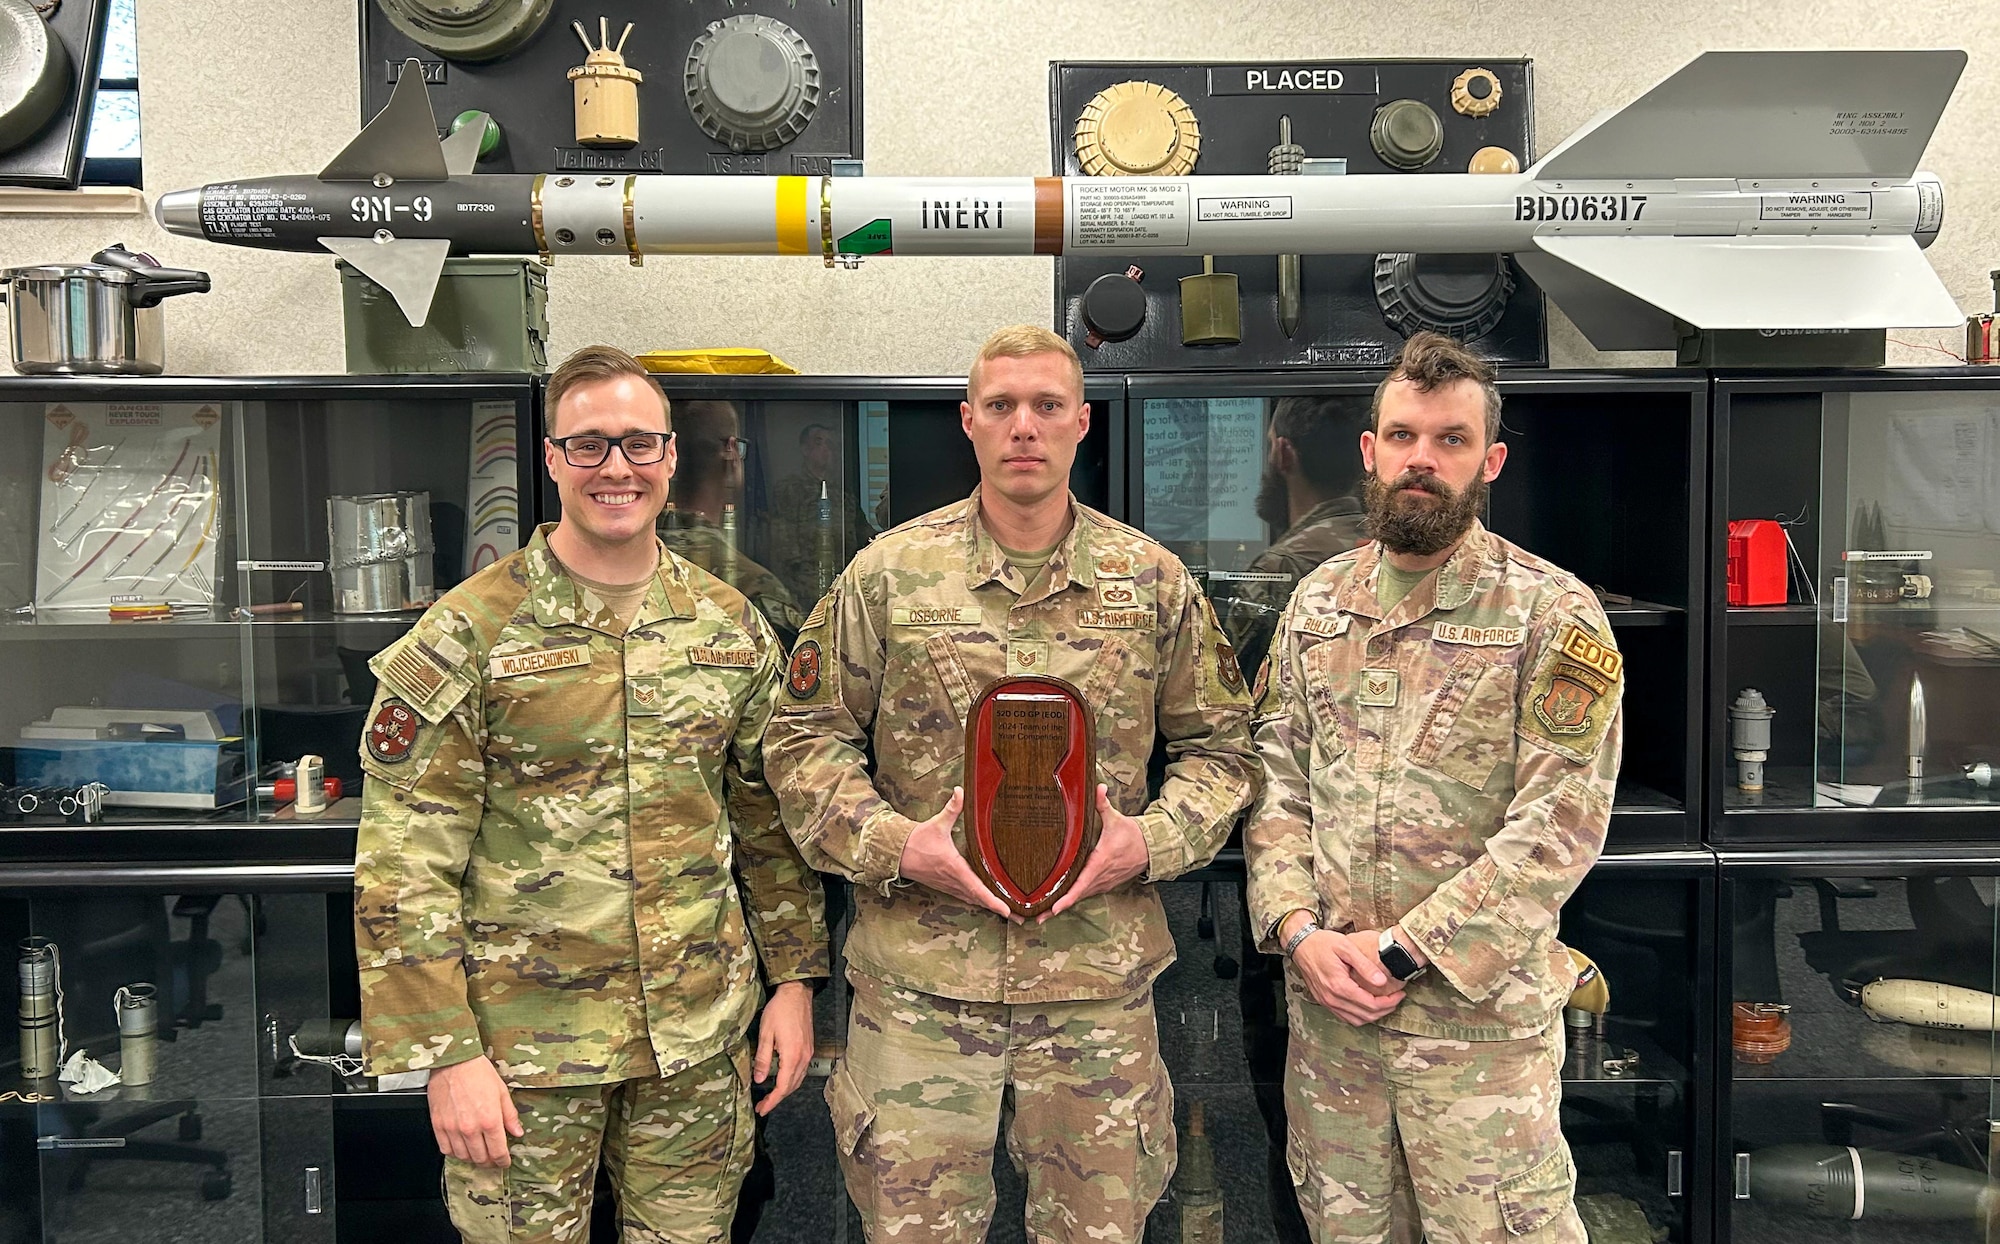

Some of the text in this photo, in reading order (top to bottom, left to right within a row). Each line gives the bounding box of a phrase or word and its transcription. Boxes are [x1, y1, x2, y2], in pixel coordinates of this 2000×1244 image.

[1247, 70, 1344, 90] PLACED
[640, 151, 658, 168] 69
[712, 158, 730, 173] VS
[1221, 200, 1269, 209] WARNING
[1789, 195, 1845, 204] WARNING
[351, 196, 432, 222] 9M-9
[1515, 196, 1647, 221] BD06317
[205, 222, 230, 233] TLM
[910, 609, 961, 623] OSBORNE
[1082, 611, 1154, 628] U.S. AIR FORCE
[1438, 624, 1519, 642] U.S. AIR FORCE
[502, 649, 580, 674] WOJCIECHOWSKI
[710, 650, 723, 664] AIR
[725, 651, 755, 665] FORCE
[1568, 632, 1618, 674] EOD
[1561, 665, 1602, 689] BREACHER
